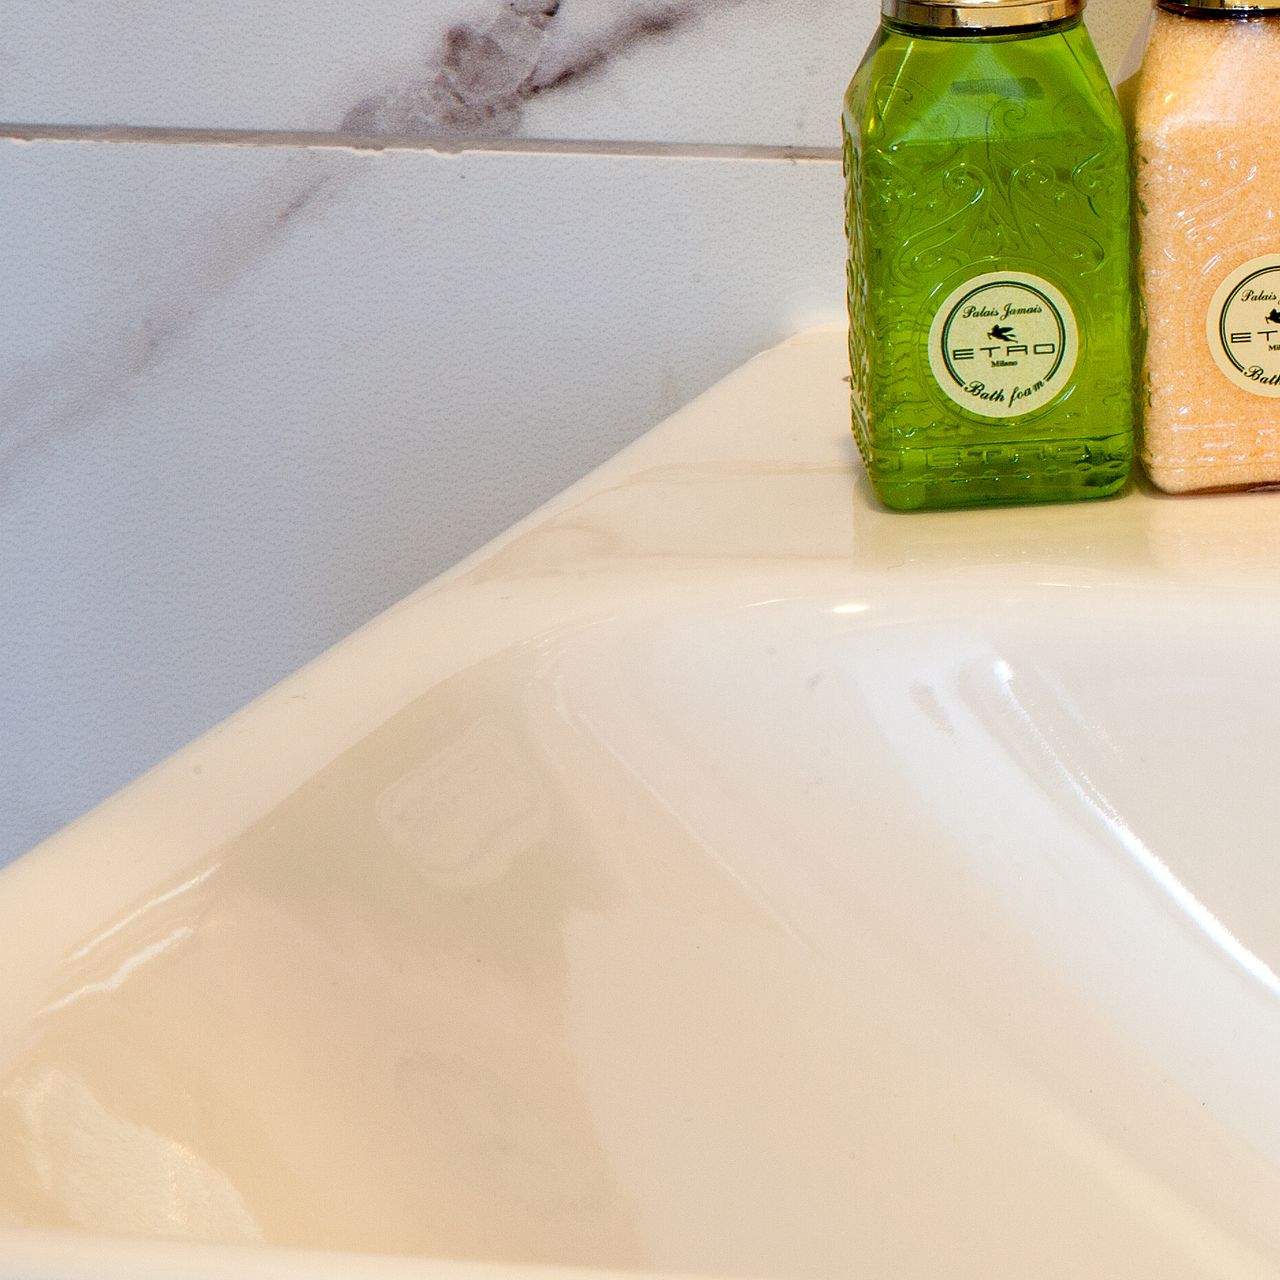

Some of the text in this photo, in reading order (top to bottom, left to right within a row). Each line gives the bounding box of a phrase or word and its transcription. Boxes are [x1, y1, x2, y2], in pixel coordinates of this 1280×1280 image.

[1240, 289, 1277, 302] Palais
[962, 303, 1043, 321] Palais Jamais
[952, 343, 1056, 360] ETRO
[991, 360, 1018, 368] Milano
[964, 380, 1045, 408] Bath foam
